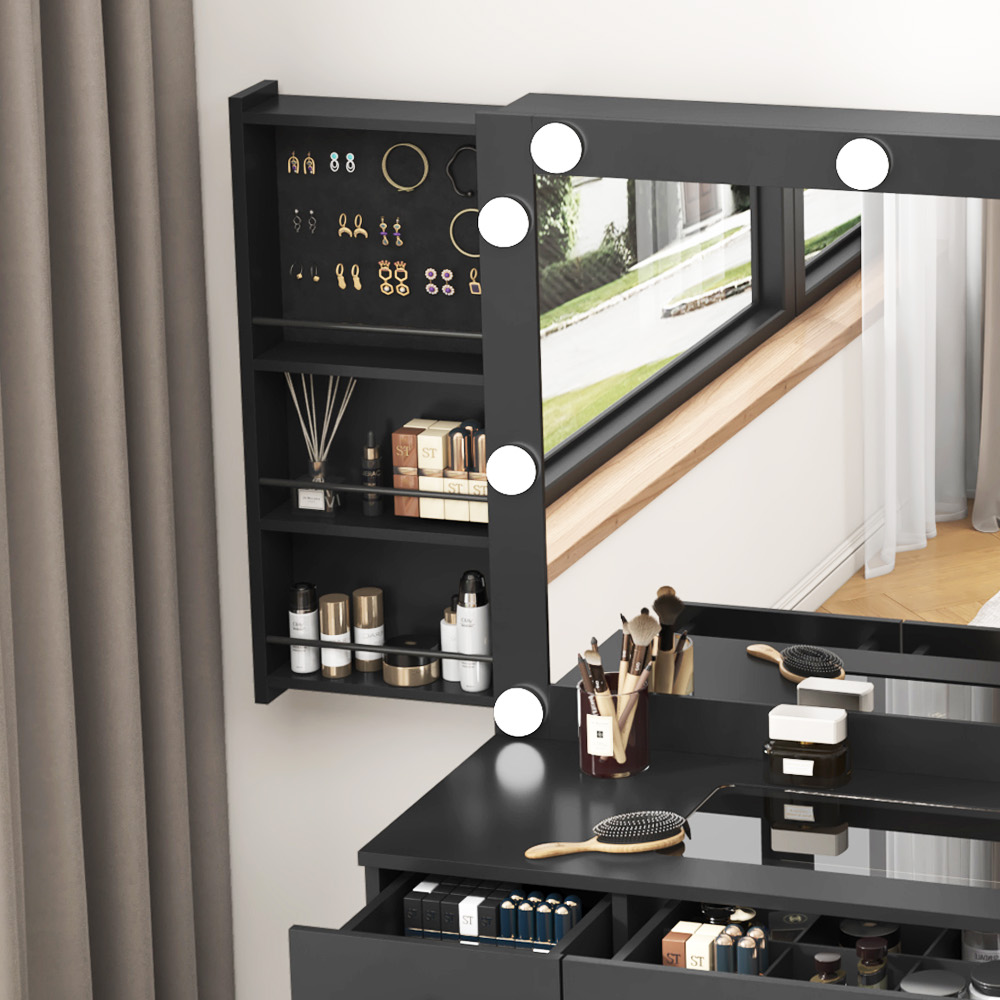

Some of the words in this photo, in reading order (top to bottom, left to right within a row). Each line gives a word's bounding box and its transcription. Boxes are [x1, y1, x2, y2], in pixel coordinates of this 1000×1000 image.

[396, 445, 410, 457] ST
[422, 447, 437, 458] ST
[448, 482, 463, 493] ST
[462, 916, 474, 925] ST
[666, 953, 681, 965] ST
[690, 955, 705, 967] ST
